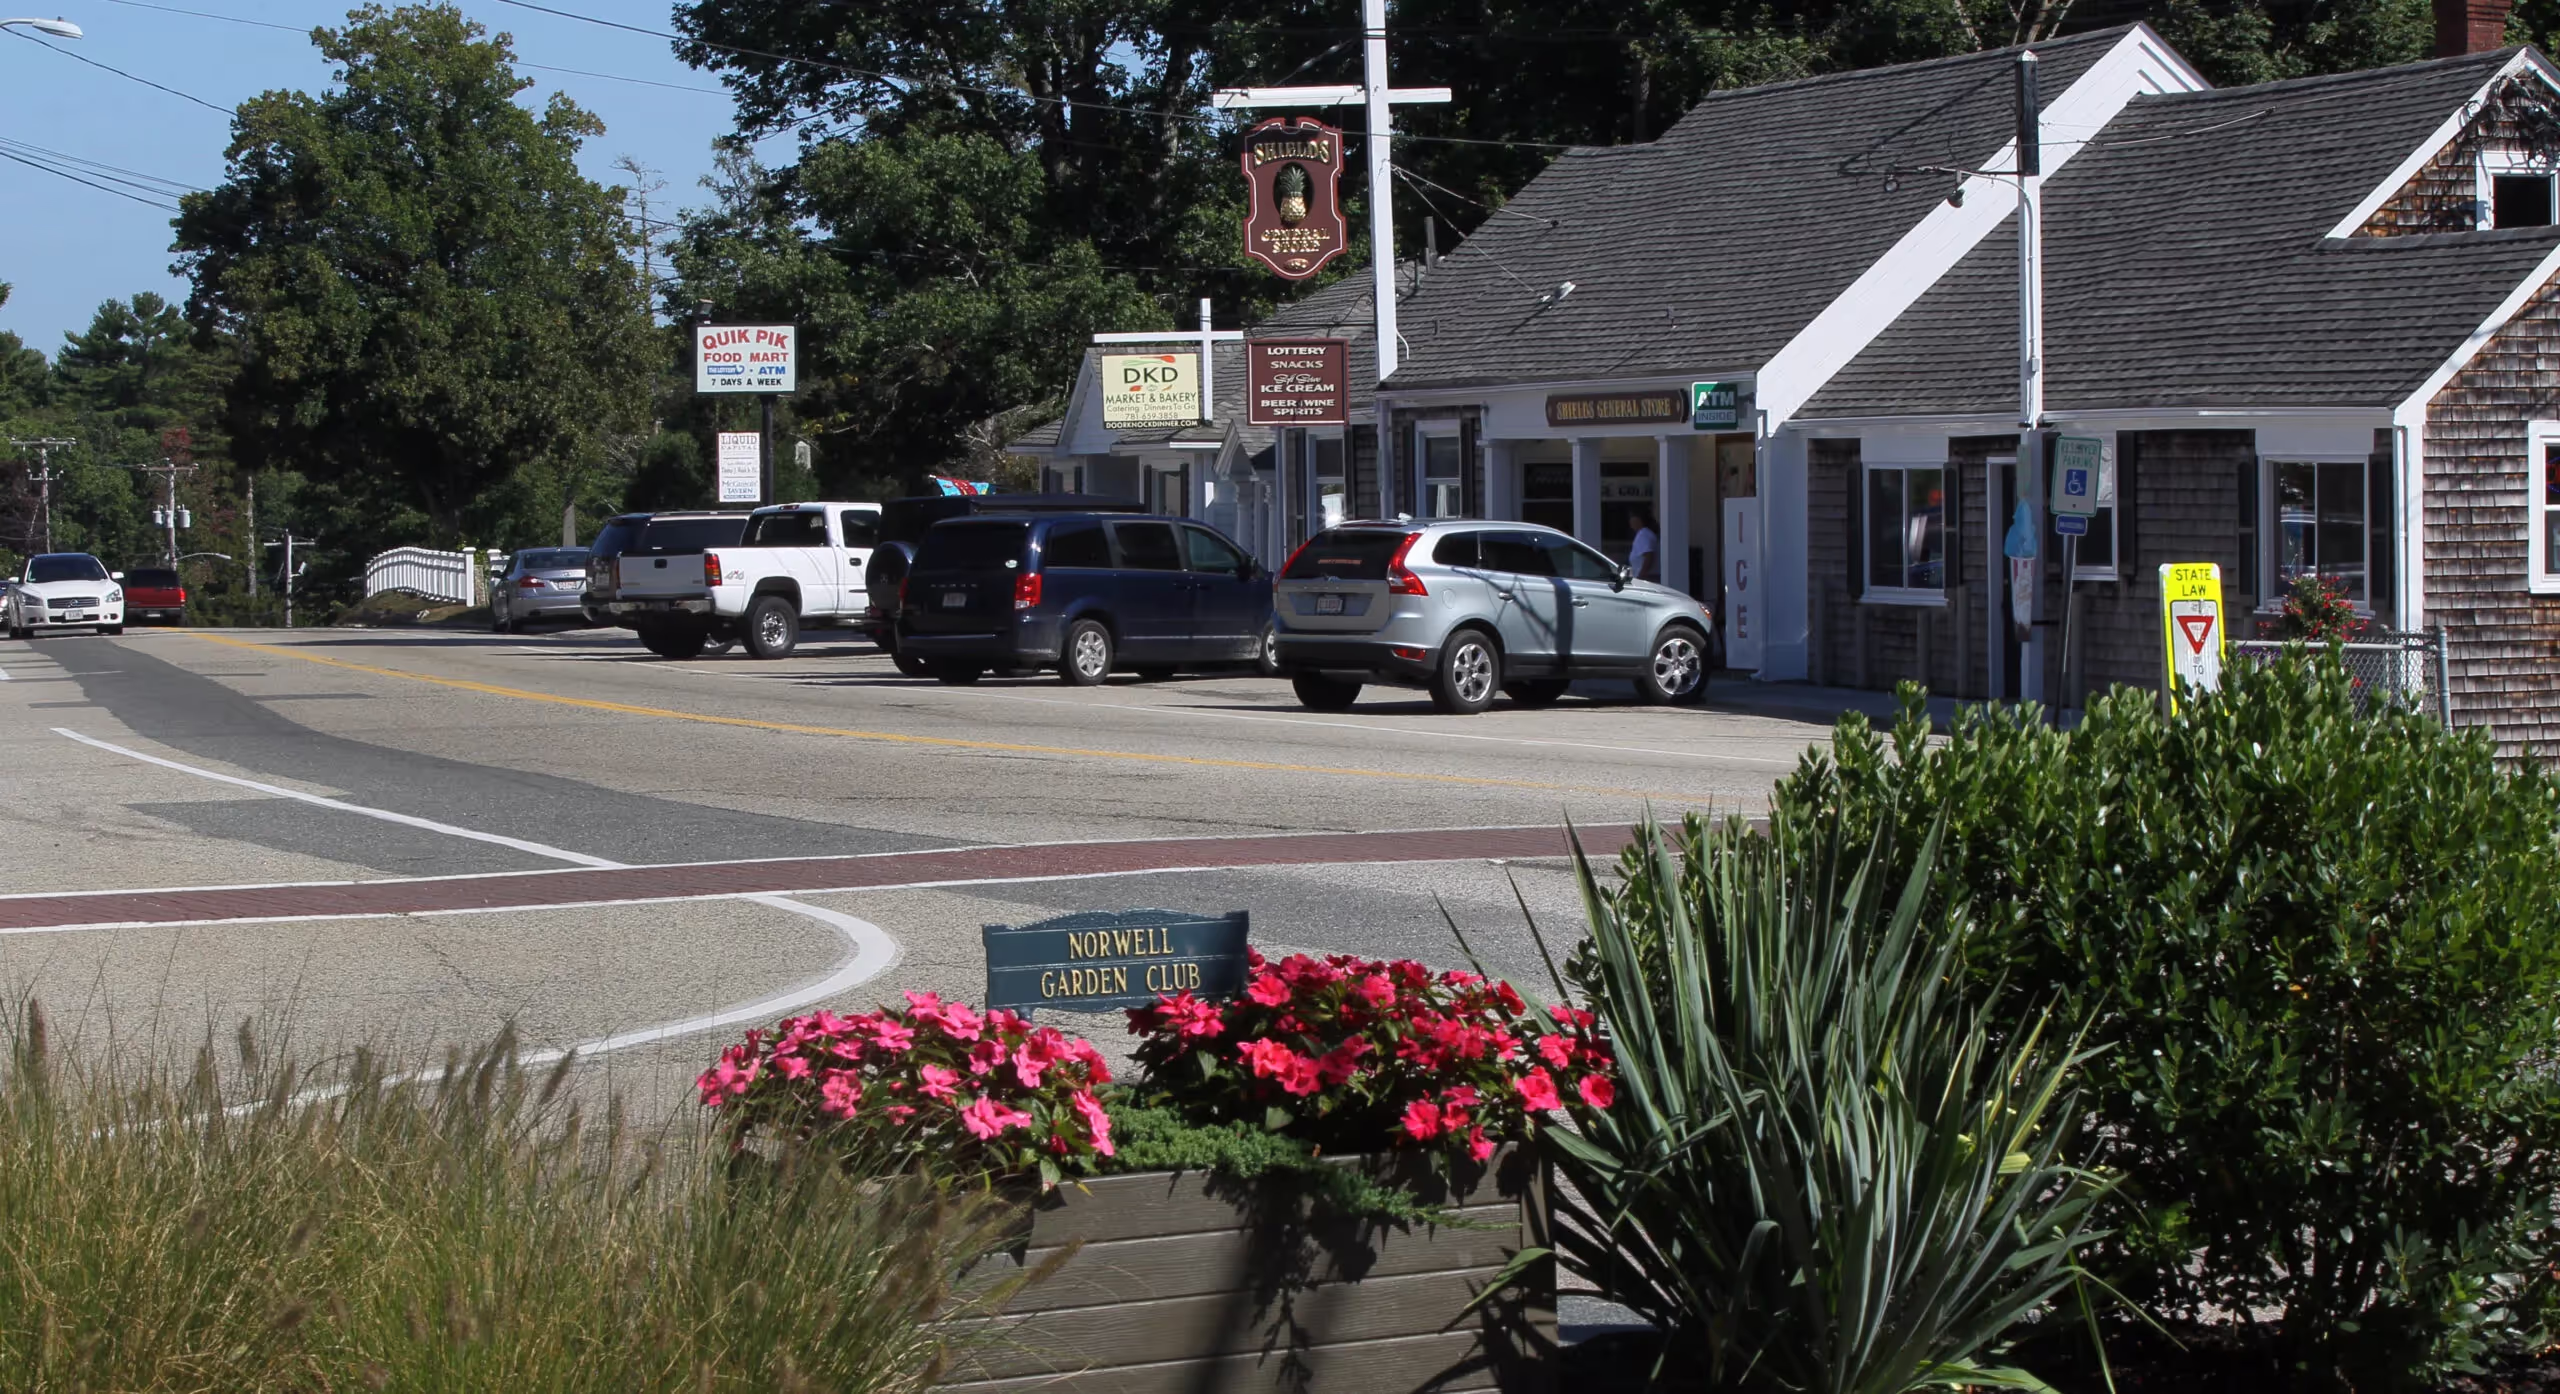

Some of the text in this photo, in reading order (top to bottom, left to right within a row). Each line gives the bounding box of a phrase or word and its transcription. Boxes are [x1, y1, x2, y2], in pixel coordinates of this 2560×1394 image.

[1254, 140, 1330, 165] SHIELDS
[1261, 228, 1330, 242] GENERAL
[1272, 240, 1320, 254] STORE
[702, 328, 789, 350] QUIK PIK
[1267, 346, 1327, 355] LOTTERY
[703, 352, 789, 363] FOOD MART
[758, 366, 786, 375] ATM
[1270, 360, 1324, 369] SNACKS
[1123, 366, 1179, 384] DKD
[711, 378, 783, 386] 7 DAYS A WEEK
[1260, 384, 1335, 393] ICE CREAM
[1105, 392, 1197, 404] MARKET & BAKERY
[1260, 398, 1335, 407] BEER WINE
[1697, 391, 1735, 407] ATM
[1106, 404, 1140, 412] Catering
[1144, 403, 1172, 411] Dinners
[1273, 407, 1324, 415] SPIRITS
[1556, 398, 1672, 420] SHIELDS GENERAL STORE
[1698, 411, 1734, 421] INSIDE
[1105, 419, 1198, 429] DOORKNOCKDINNER.COM
[721, 435, 757, 445] LIQUID
[2063, 455, 2095, 468] PARKING
[1735, 511, 1748, 639] ICE
[2175, 568, 2211, 581] STATE
[2181, 584, 2207, 597] LAW
[2193, 665, 2204, 675] TO
[1068, 927, 1175, 960] NORWELL
[1040, 963, 1201, 999] GARDEN CLUB
